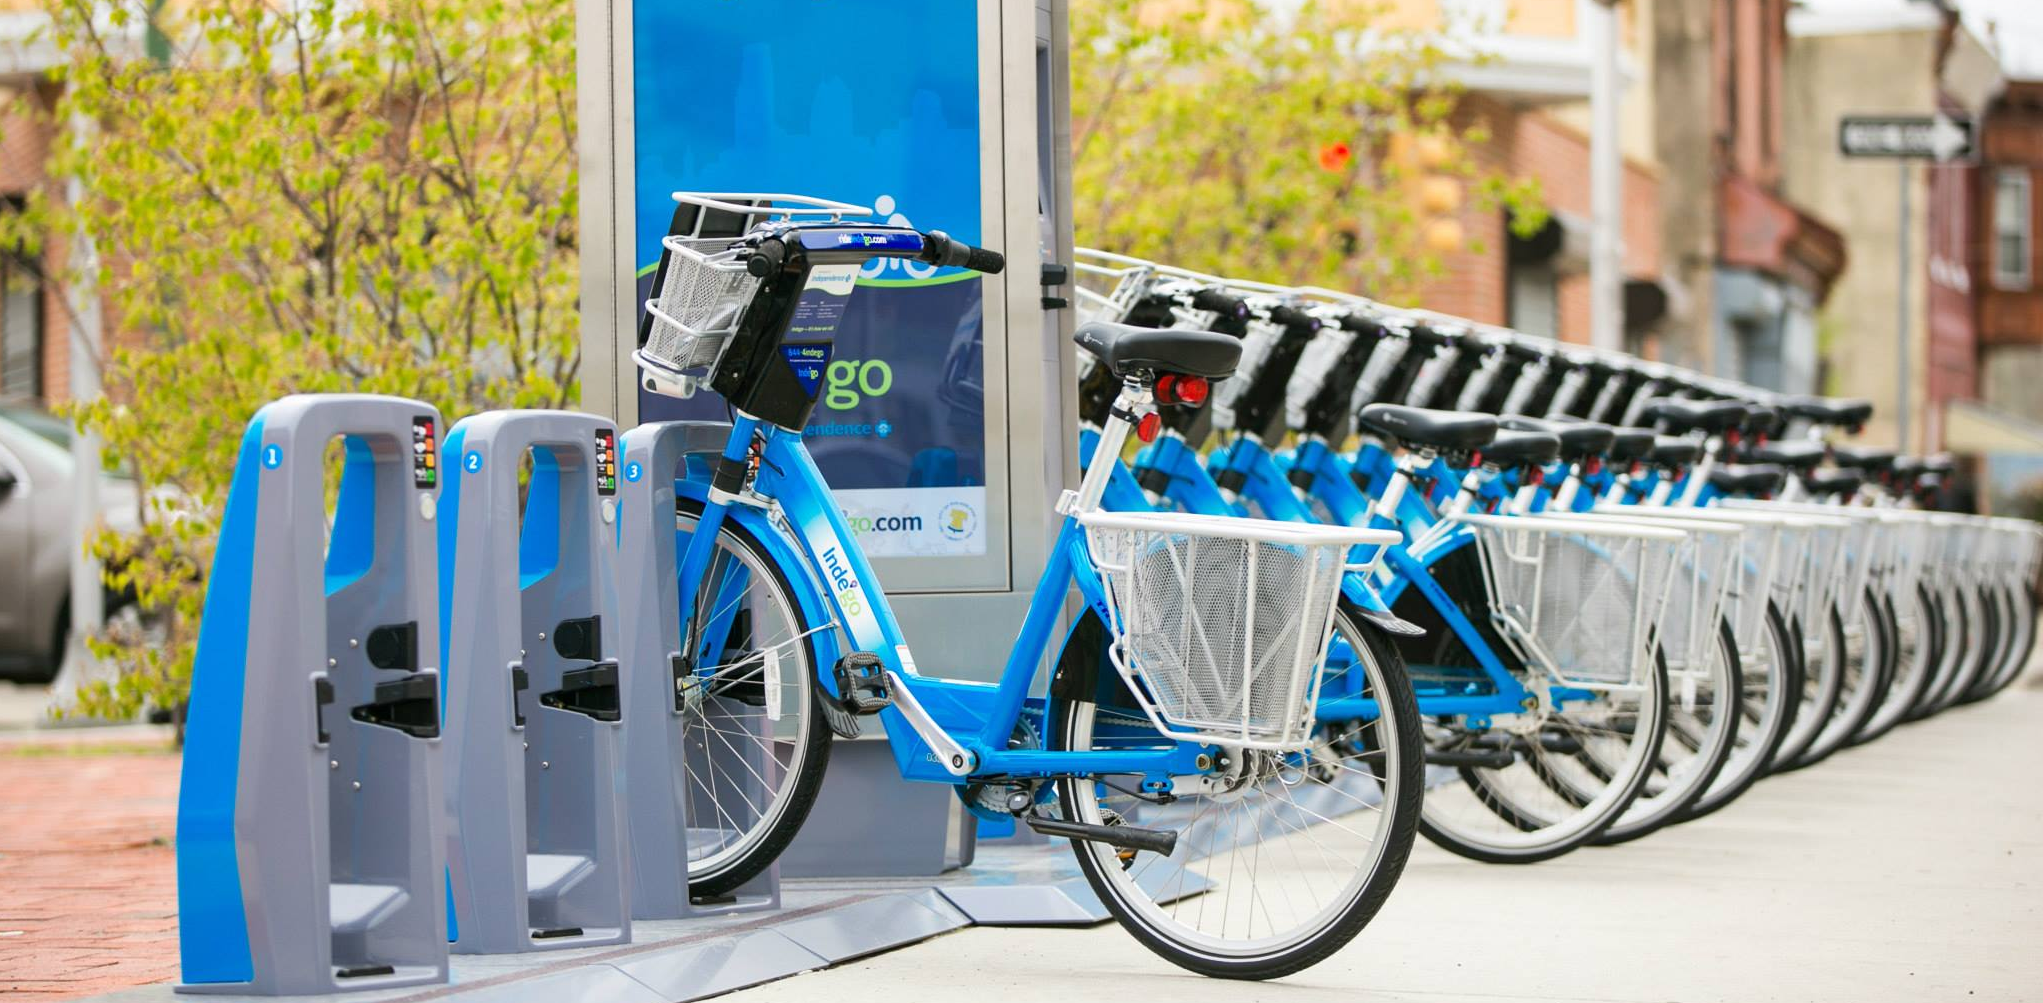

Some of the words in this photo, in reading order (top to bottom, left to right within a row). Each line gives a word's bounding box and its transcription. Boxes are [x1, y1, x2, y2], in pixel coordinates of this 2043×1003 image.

[268, 448, 277, 465] 1
[469, 454, 478, 469] 2
[630, 465, 638, 478] 3
[822, 546, 861, 617] Indego
